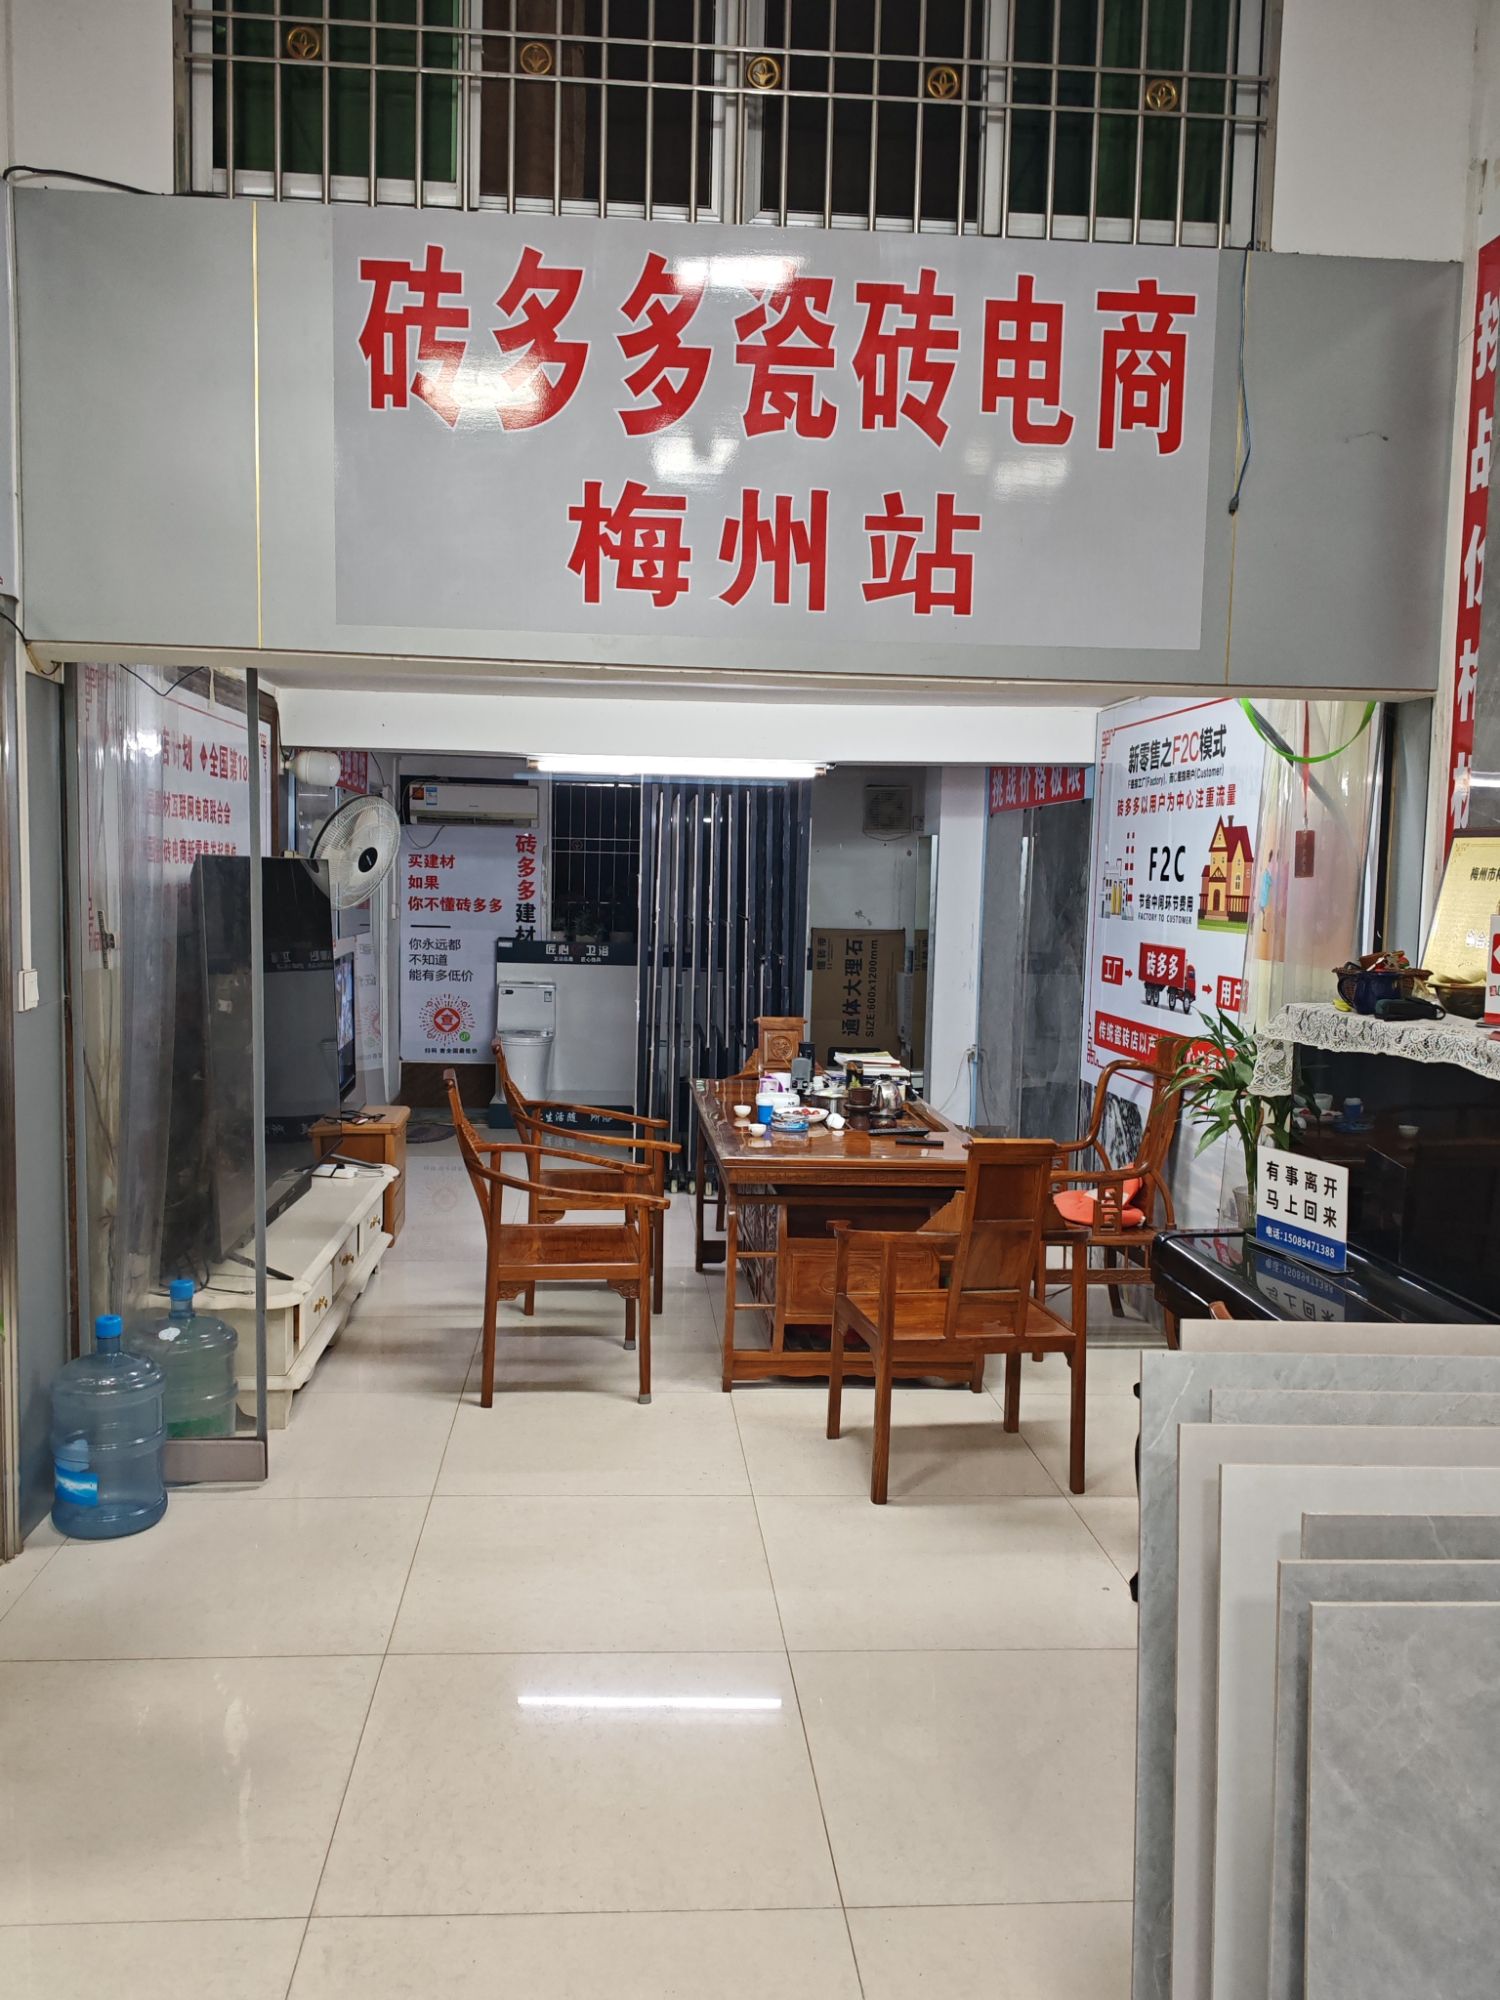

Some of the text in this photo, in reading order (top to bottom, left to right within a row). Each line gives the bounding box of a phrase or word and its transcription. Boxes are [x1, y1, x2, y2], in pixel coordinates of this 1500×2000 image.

[359, 245, 1197, 456] 砖多多瓷砖电商
[567, 480, 982, 616] 梅州站
[1128, 724, 1227, 773] 新零售之F2C模式
[408, 854, 455, 869] 买建材
[1149, 846, 1186, 882] F2C
[408, 875, 439, 890] 如果
[408, 896, 502, 913] 你不懂砖多多
[409, 938, 461, 951] 你永远都
[409, 954, 448, 966] 不知道
[1104, 959, 1121, 980] 工厂
[1146, 951, 1179, 980] 砖多多
[409, 969, 474, 982] 能有多低价
[841, 938, 863, 1036] 通体大理石
[1266, 1160, 1338, 1198] 有事离开
[1266, 1189, 1338, 1229] 马上回来
